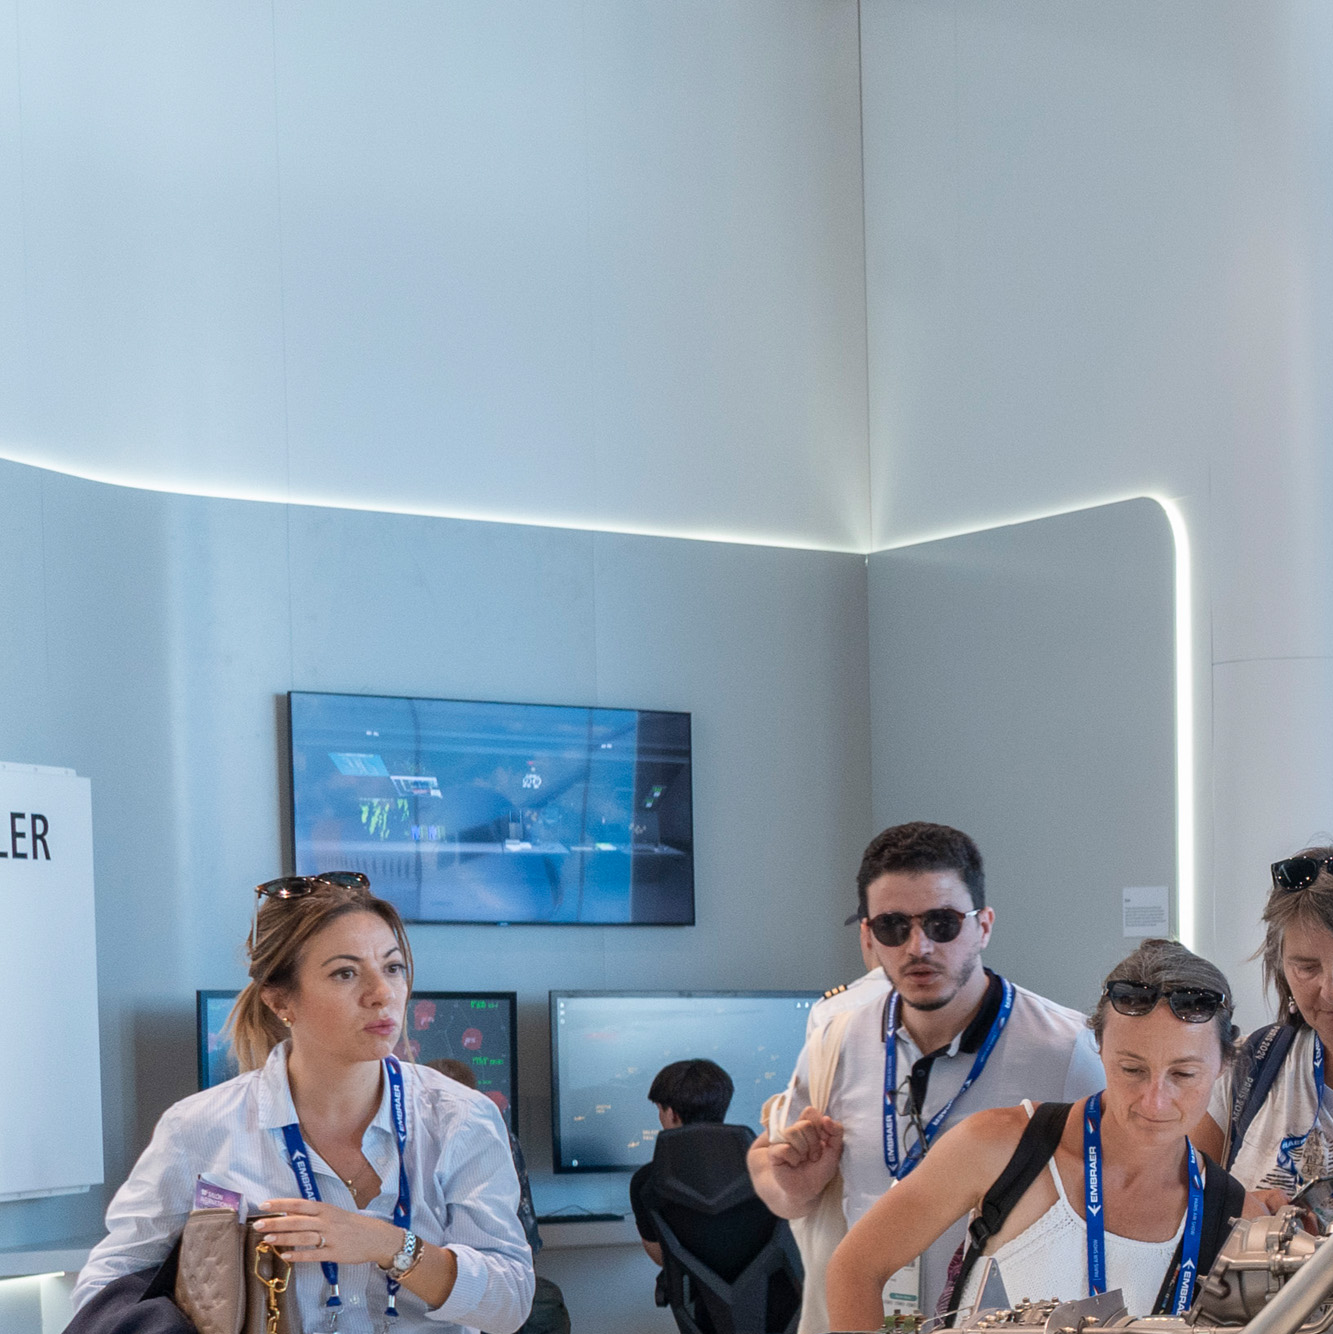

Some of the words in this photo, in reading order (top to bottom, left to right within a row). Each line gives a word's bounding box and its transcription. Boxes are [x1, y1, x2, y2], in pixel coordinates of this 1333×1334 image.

[1255, 1041, 1271, 1060] 2024
[1238, 1076, 1254, 1099] PARIS
[393, 1084, 405, 1132] EMBRAER
[1232, 1099, 1245, 1122] 2024
[887, 1115, 895, 1162] EMBRAER
[1089, 1146, 1098, 1203] EMBRAER
